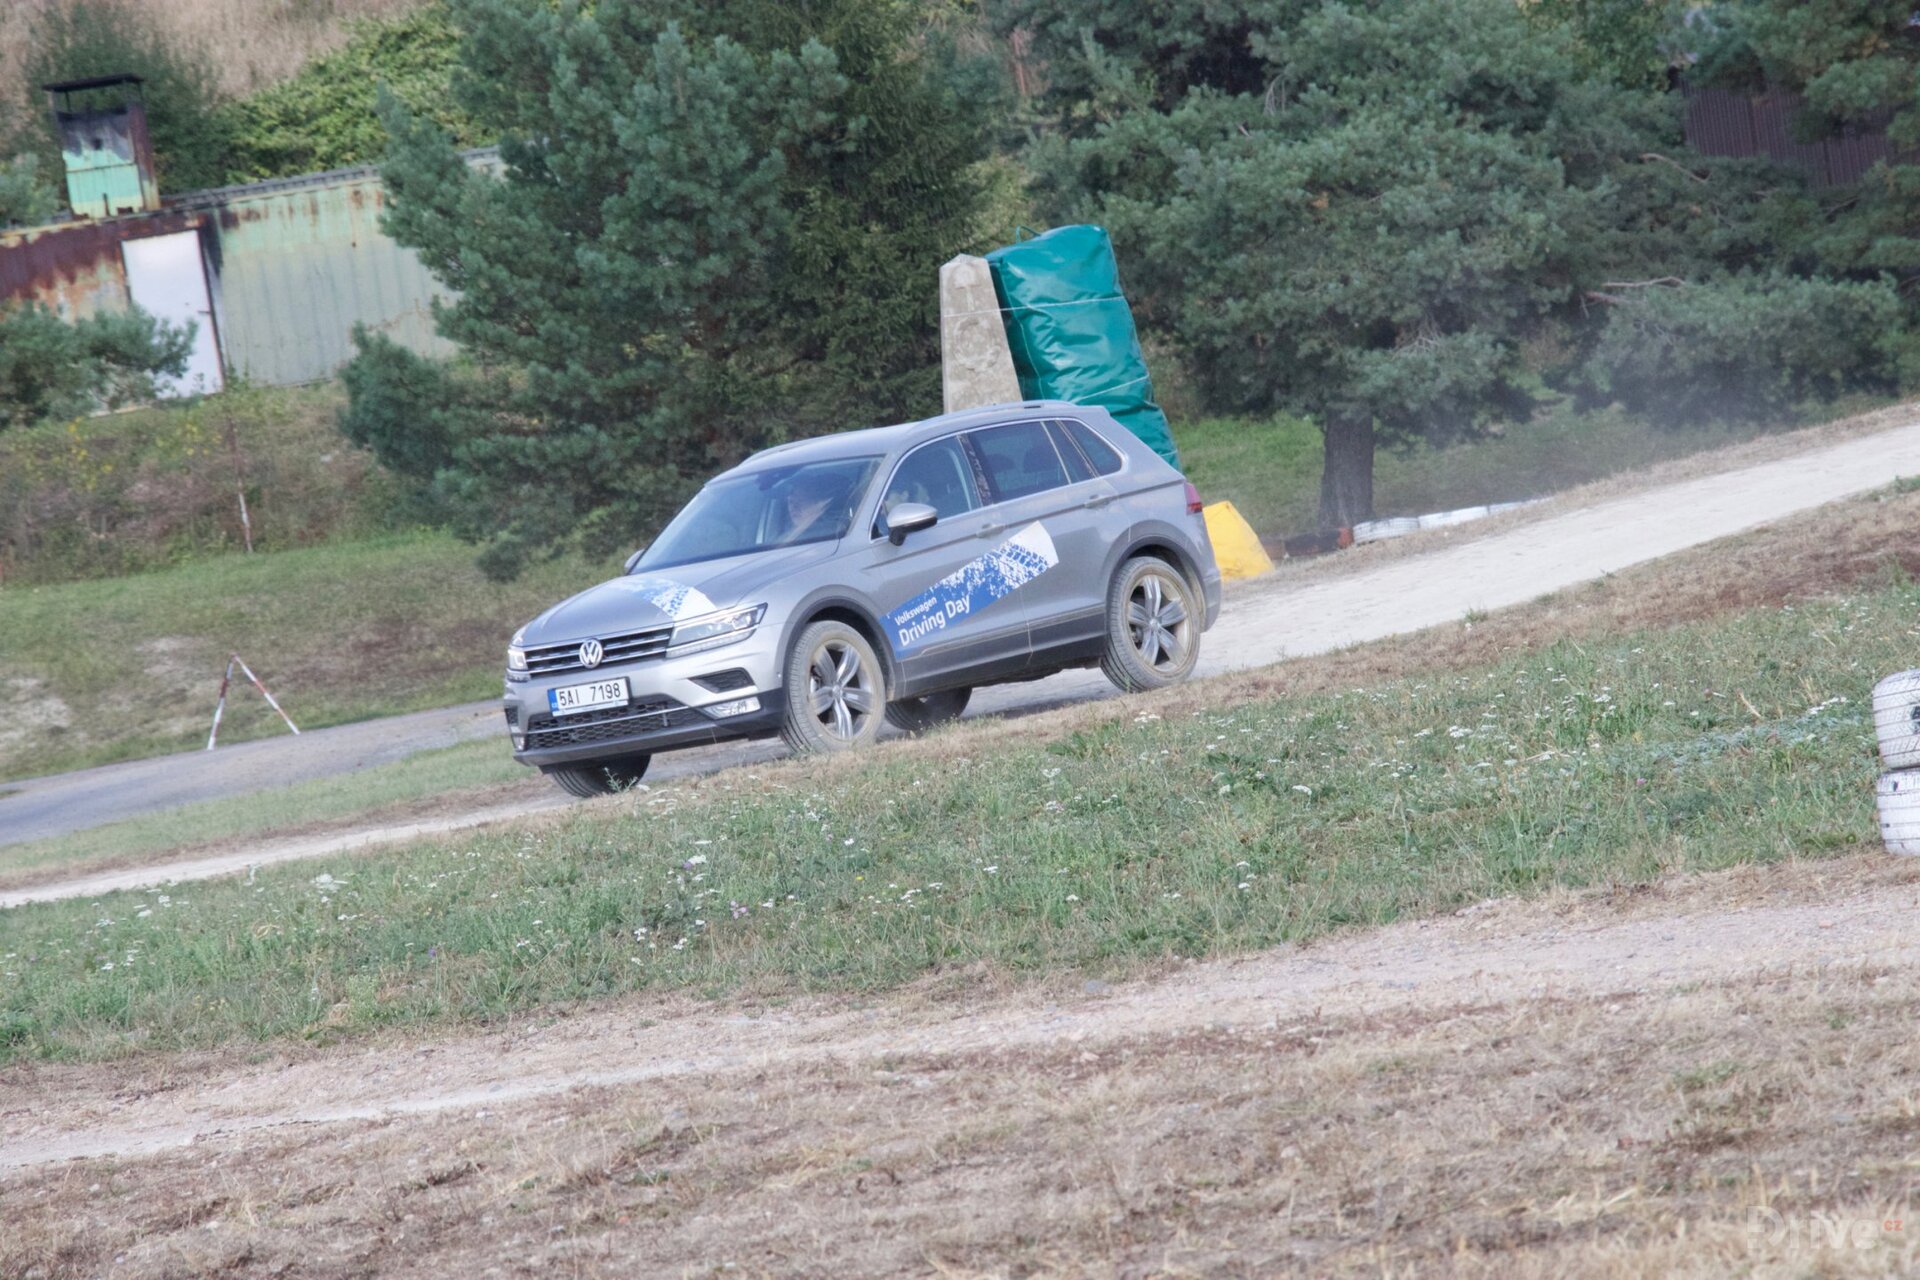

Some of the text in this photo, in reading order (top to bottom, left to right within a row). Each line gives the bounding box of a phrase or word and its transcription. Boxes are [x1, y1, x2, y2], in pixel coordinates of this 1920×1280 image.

[894, 596, 937, 626] Volkswagen
[898, 594, 970, 646] Driving Day
[589, 683, 621, 701] 7198
